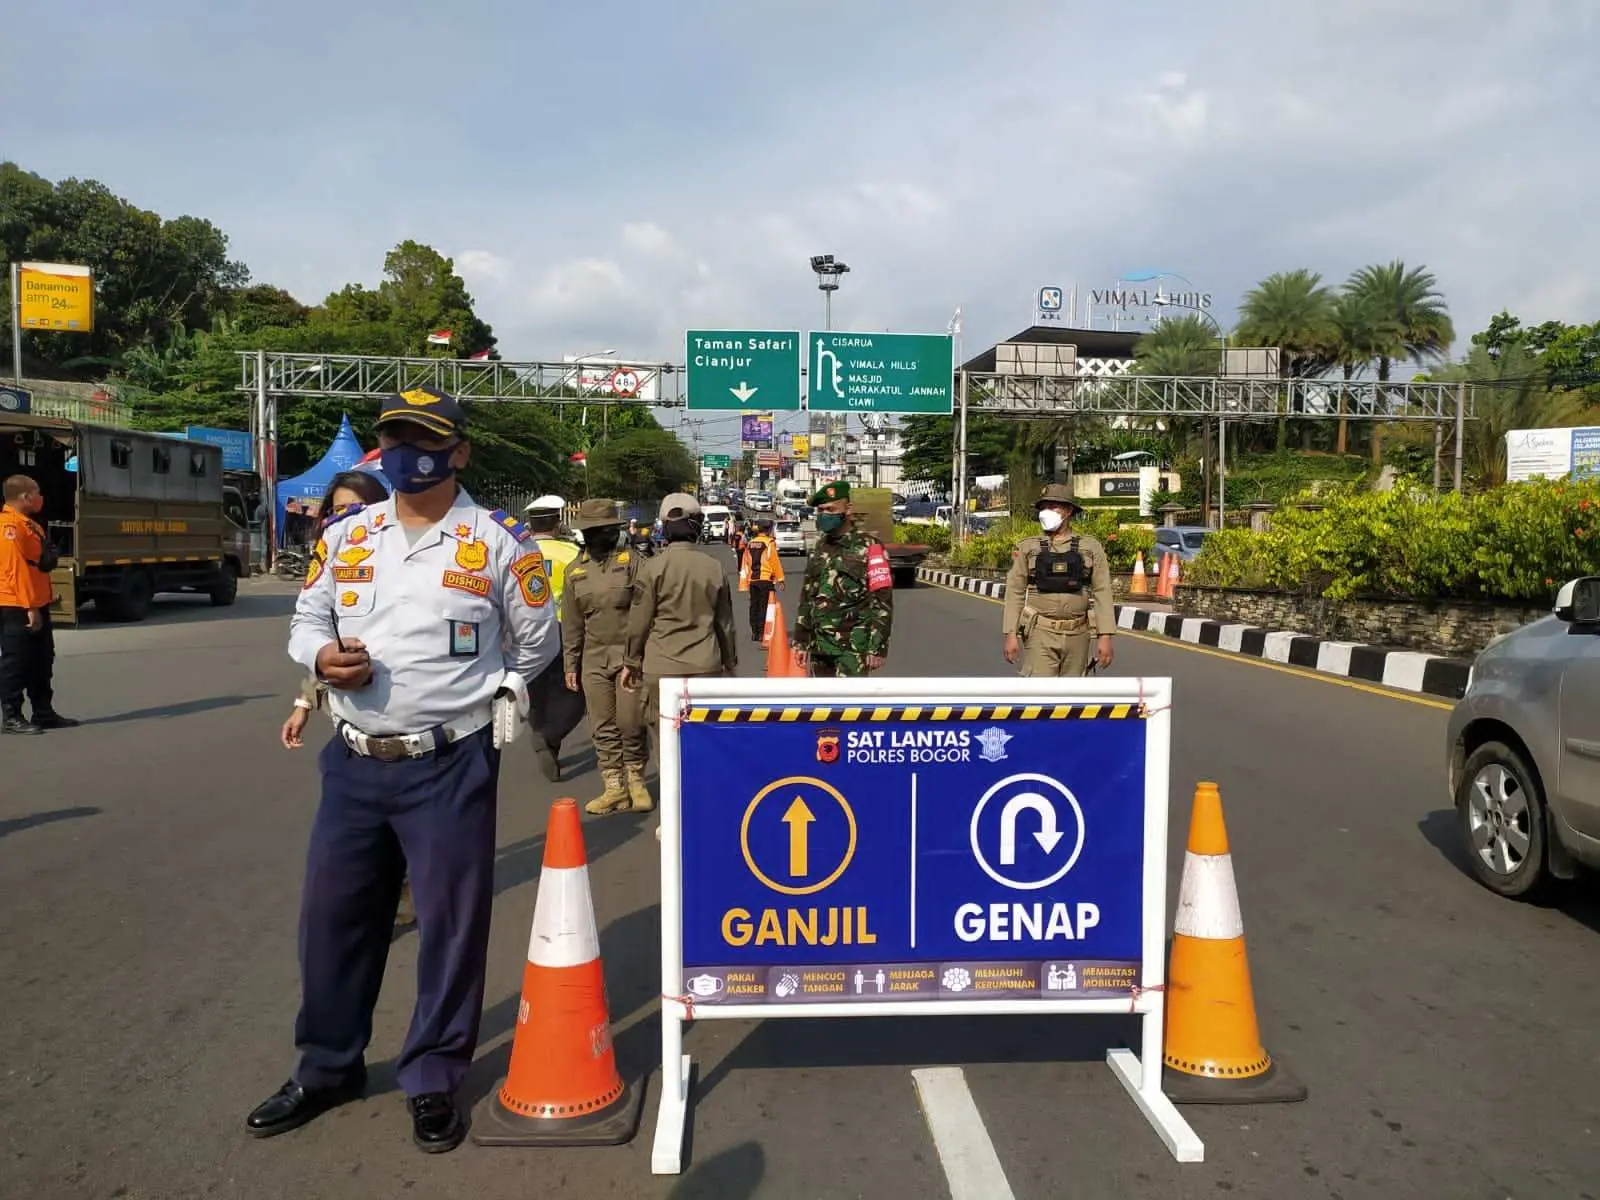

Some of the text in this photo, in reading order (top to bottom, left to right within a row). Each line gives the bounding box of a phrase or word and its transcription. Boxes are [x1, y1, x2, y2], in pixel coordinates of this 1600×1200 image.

[26, 281, 79, 293] Danamon
[26, 294, 49, 303] atm
[695, 338, 793, 351] Taman Safari
[831, 338, 873, 348] CISARUA
[694, 355, 753, 371] Cianjur
[849, 360, 918, 371] VIMALA HILLS
[848, 375, 882, 384] MASJID
[848, 386, 946, 396] HARAKATUL JANNAH
[848, 398, 875, 407] CIAWI
[447, 574, 485, 591] DISHUB
[847, 730, 971, 748] SAT LANTAS
[847, 748, 971, 763] POLRES BOGOR
[721, 907, 877, 947] GANJIL
[954, 902, 1101, 943] GENAP
[803, 972, 845, 982] MENCUCI
[889, 970, 936, 981] MENJAGA
[975, 968, 1024, 978] MENJAUHI
[1083, 967, 1136, 977] MEMBATASI
[727, 972, 755, 983] PAKAI
[803, 983, 843, 993] TANGAN
[890, 982, 919, 992] JARAK
[975, 979, 1036, 990] KERUMUNAN
[1083, 979, 1133, 988] MOBILITAS
[727, 984, 765, 994] MASKER
